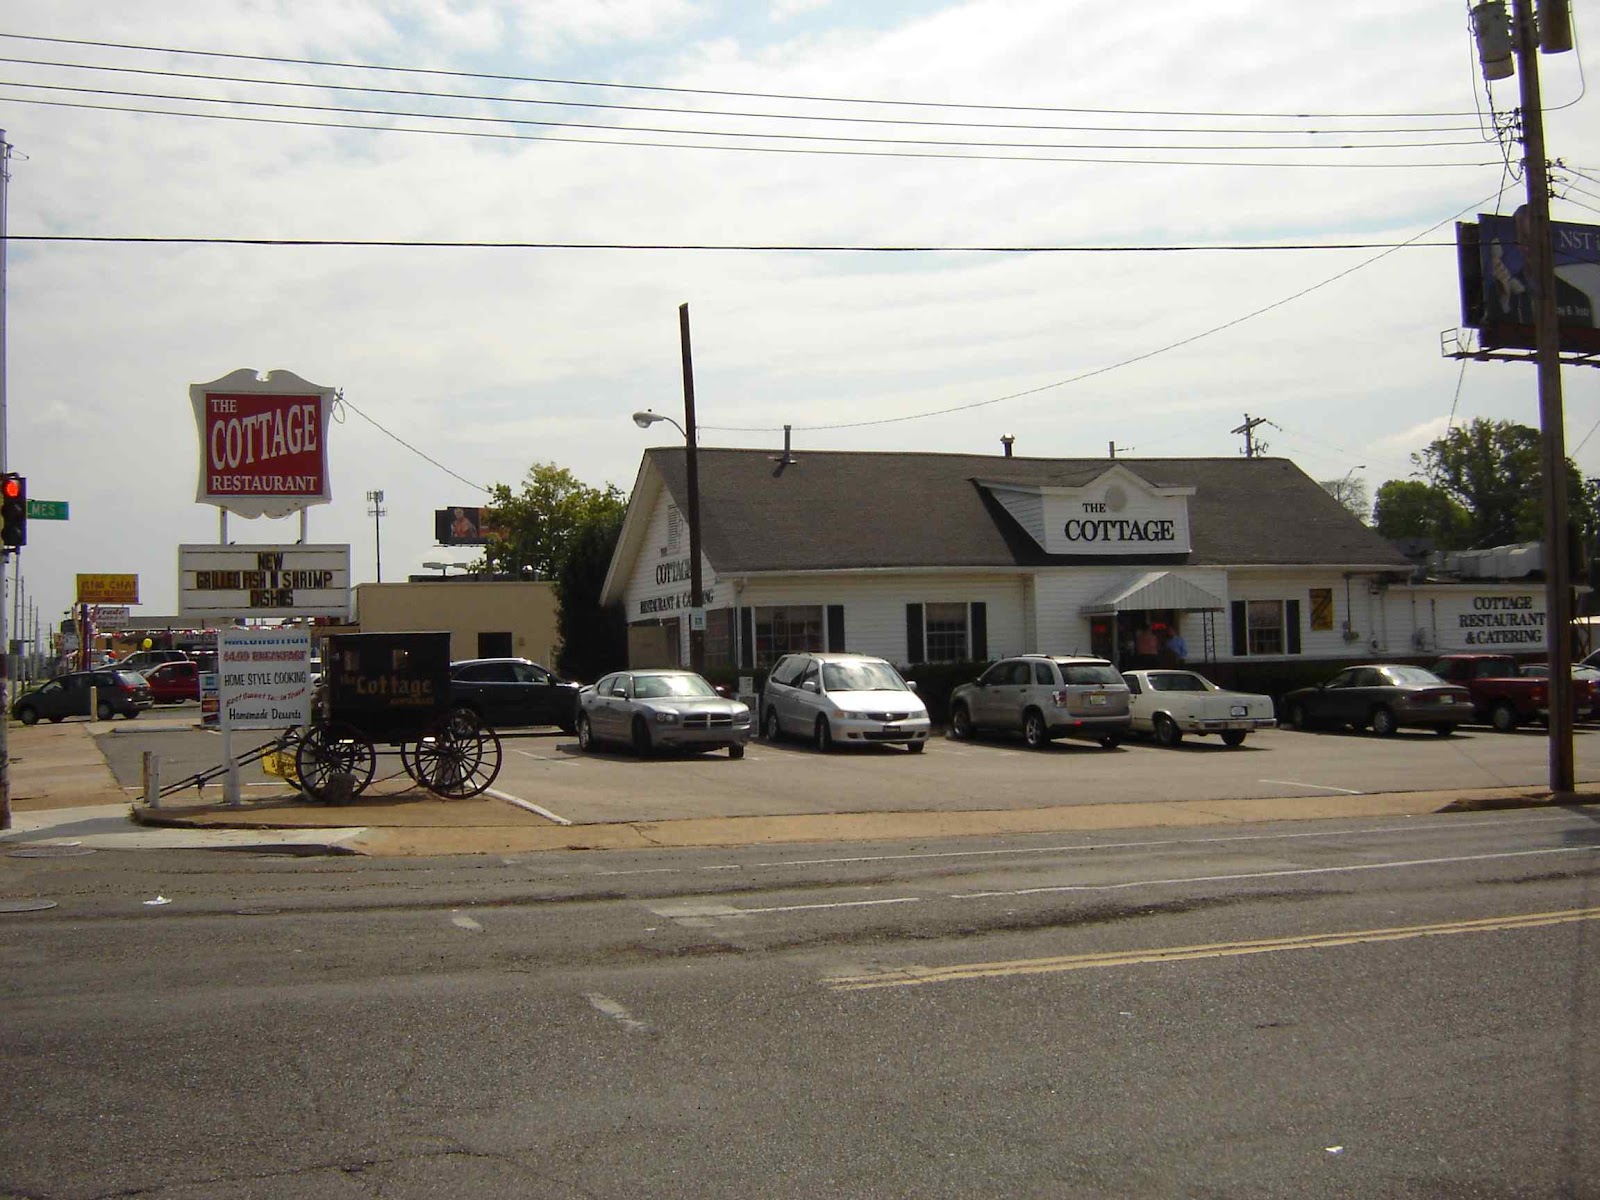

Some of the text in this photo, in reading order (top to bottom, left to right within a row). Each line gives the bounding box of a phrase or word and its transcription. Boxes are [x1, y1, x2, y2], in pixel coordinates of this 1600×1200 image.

[211, 399, 237, 413] THE
[211, 404, 317, 470] COTTAGE
[211, 475, 317, 491] RESTAURANT
[1082, 503, 1106, 513] THE
[1064, 519, 1175, 542] COTTAGE
[257, 552, 284, 570] NEW
[196, 570, 333, 589] GRILLED FISH N SHRIMP
[1473, 596, 1532, 610] COTTAGE
[1459, 612, 1546, 628] RESTAURANT
[1465, 630, 1542, 644] & CATERING
[224, 671, 307, 687] HOME STYLE COOKING
[356, 673, 433, 698] Cottage
[229, 708, 302, 720] Homemade Desserts
